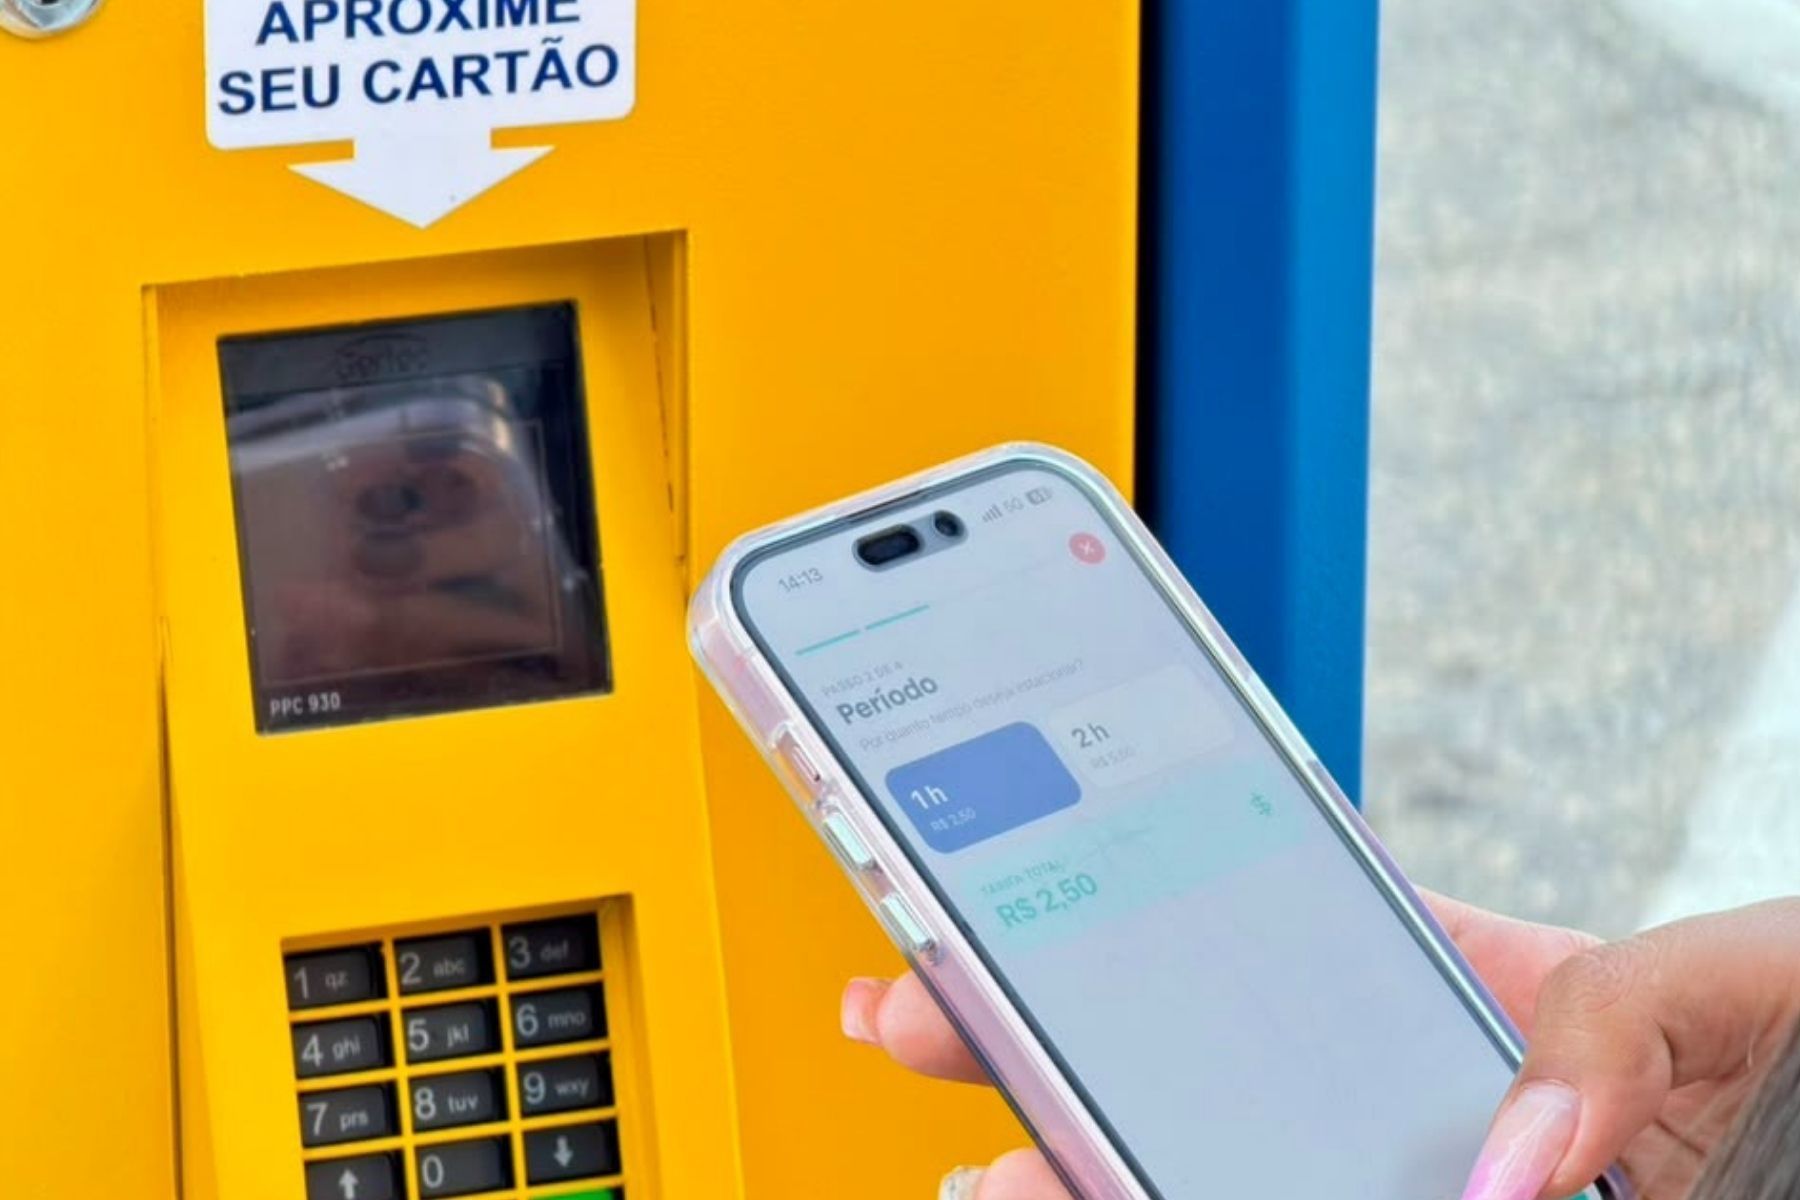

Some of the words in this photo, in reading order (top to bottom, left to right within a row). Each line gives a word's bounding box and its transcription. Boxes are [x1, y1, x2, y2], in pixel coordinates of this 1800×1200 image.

[255, 0, 581, 46] APROXIME
[217, 64, 340, 116] SEU
[362, 36, 620, 104] CARTÃO
[777, 567, 824, 592] 14:13
[269, 695, 304, 718] PPC
[307, 691, 341, 715] 930
[836, 675, 940, 725] Período
[859, 733, 885, 752] Por
[886, 716, 931, 744] quanto
[930, 702, 973, 726] tempo
[1071, 727, 1095, 749] 2
[1086, 722, 1112, 745] h
[911, 789, 929, 810] 1
[922, 784, 948, 806] h
[1035, 872, 1098, 914] 2,50
[400, 952, 422, 985] 2
[433, 956, 466, 977] abc
[508, 937, 532, 969] 3
[540, 938, 570, 960] def
[293, 967, 310, 1000] 1
[324, 970, 348, 990] qz
[407, 1018, 430, 1052] 5
[446, 1023, 469, 1048] jkl
[515, 1003, 539, 1037] 6
[548, 1008, 587, 1029] mno
[301, 1034, 325, 1067] 4
[332, 1036, 361, 1060] ghi
[414, 1087, 437, 1121] 8
[447, 1092, 479, 1113] tuv
[522, 1071, 546, 1105] 9
[554, 1076, 591, 1098] wxy
[307, 1103, 328, 1136] 7
[339, 1110, 369, 1132] prs
[421, 1155, 444, 1188] 0
